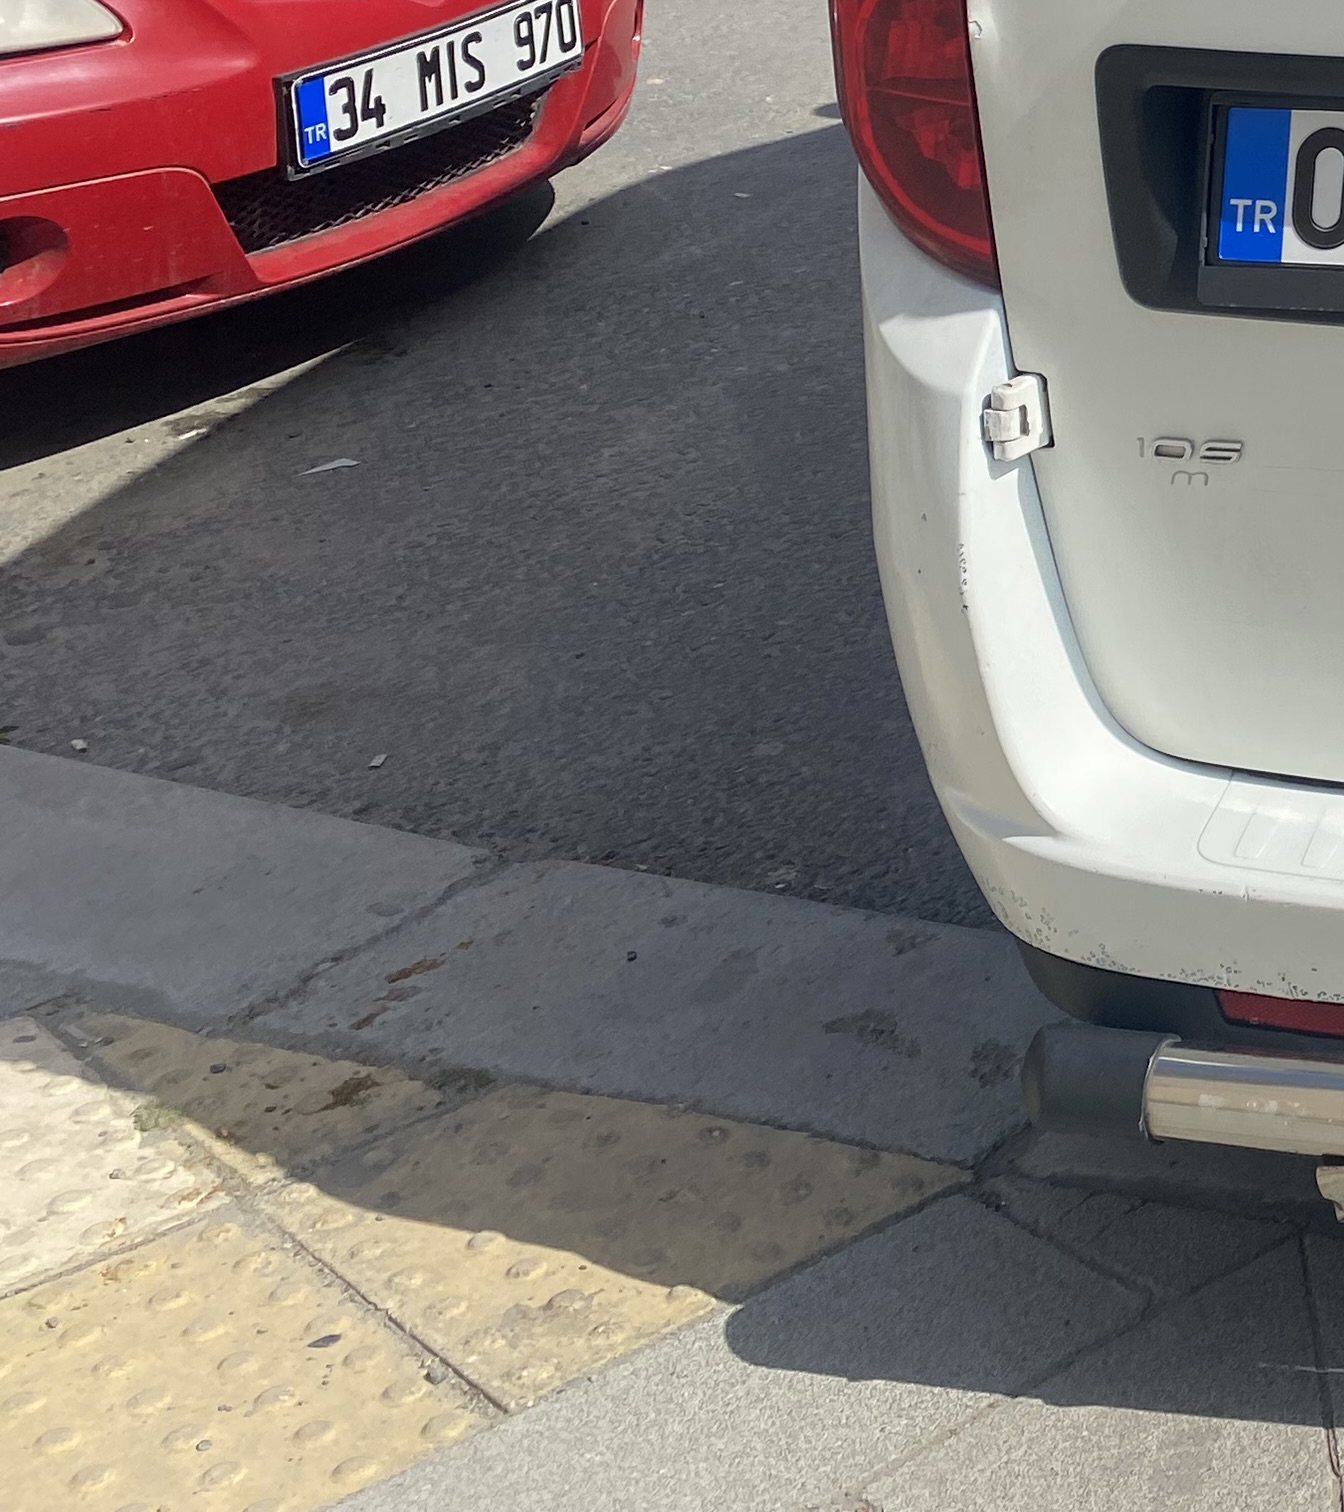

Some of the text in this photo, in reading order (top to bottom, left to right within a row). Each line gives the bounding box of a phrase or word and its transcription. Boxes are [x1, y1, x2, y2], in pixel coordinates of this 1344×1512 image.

[303, 122, 328, 145] TR
[328, 68, 387, 142] 34
[417, 31, 486, 112] MIS
[1230, 196, 1276, 235] TR
